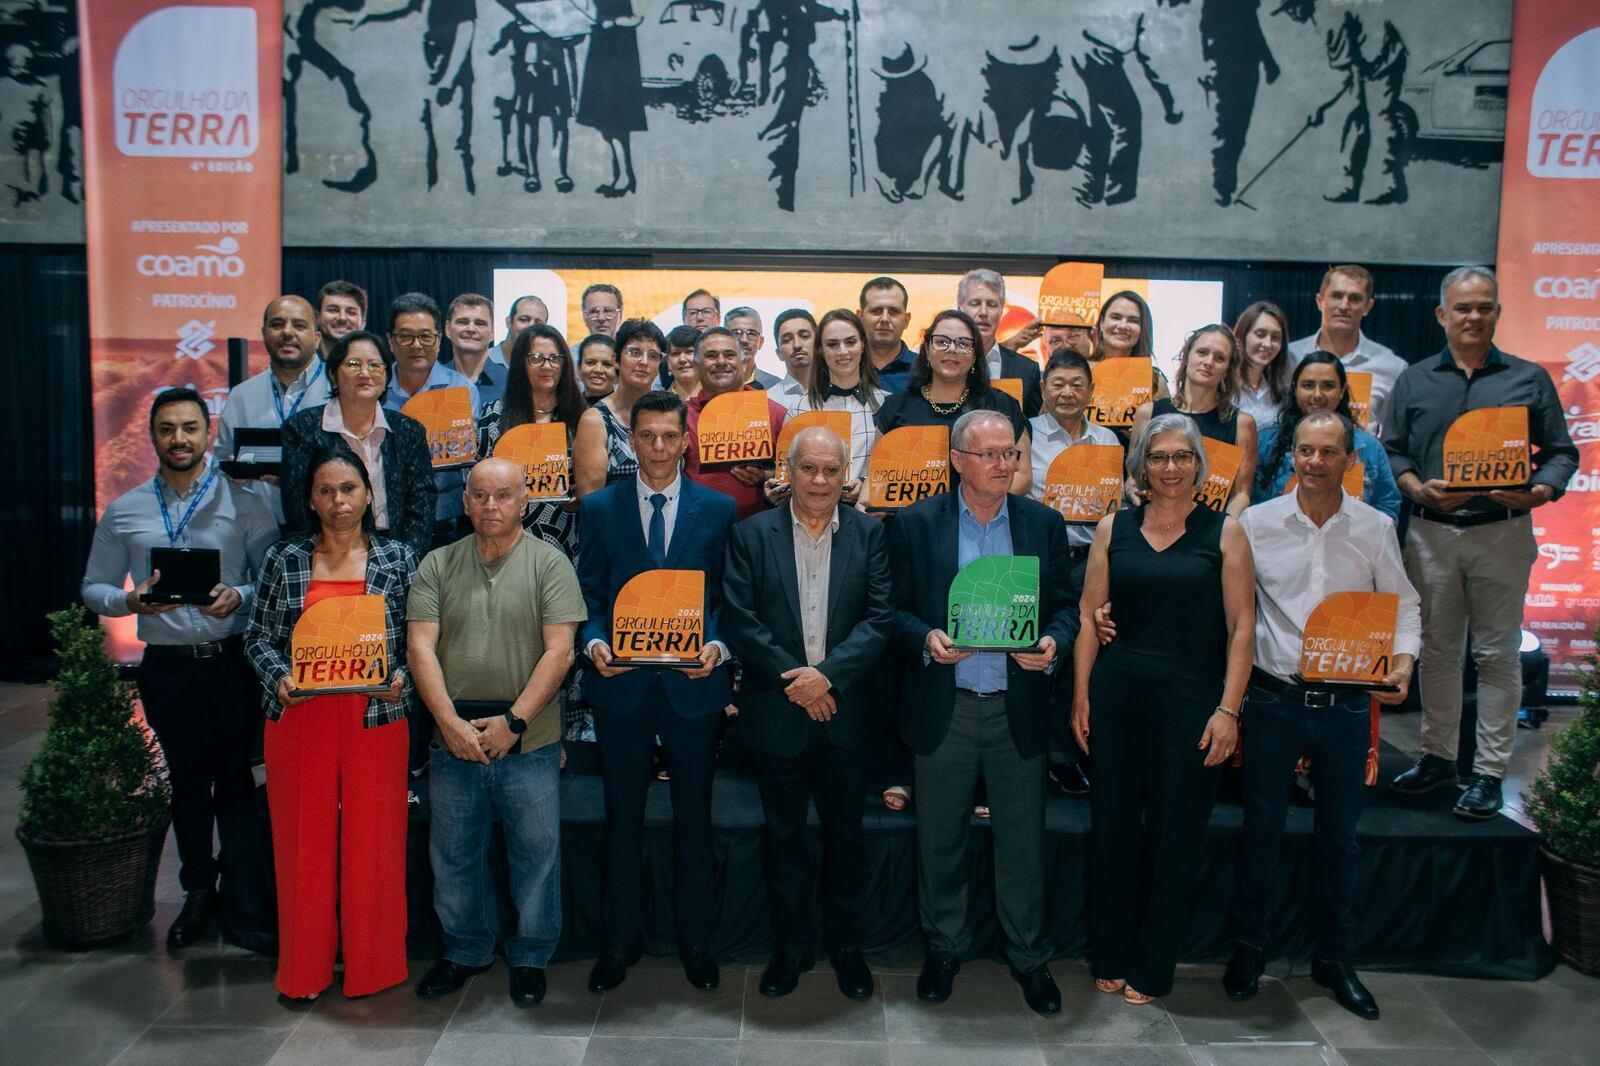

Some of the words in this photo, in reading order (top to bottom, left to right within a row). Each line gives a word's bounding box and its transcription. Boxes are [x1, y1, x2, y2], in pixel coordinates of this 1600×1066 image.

[123, 89, 219, 111] ORGULHO
[224, 91, 250, 111] DA
[124, 112, 250, 146] TERRA
[131, 220, 220, 233] APRESENTADO
[222, 221, 249, 234] POR
[136, 254, 245, 277] coamo
[152, 291, 237, 309] PATROCÍNIO
[1040, 295, 1085, 307] ORGULHO
[452, 419, 471, 427] 2024
[700, 430, 753, 444] ORGULHO
[754, 429, 770, 440] DA
[701, 440, 772, 461] TERRA
[925, 460, 946, 468] 2024
[1446, 461, 1527, 482] TERRA
[872, 469, 929, 482] ORGULHO
[931, 468, 948, 481] DA
[1099, 477, 1120, 486] 2024
[1012, 594, 1036, 603] 2024
[678, 608, 701, 617] 2024
[1017, 605, 1037, 619] DA
[615, 616, 681, 631] ORGULHO
[683, 618, 701, 631] DA
[950, 618, 1035, 641] TERRA
[359, 633, 384, 642] 2024
[616, 630, 700, 652] TERRA
[1368, 631, 1392, 640] 2024
[294, 643, 363, 661] ORGULHO
[365, 642, 385, 657] DA
[1304, 637, 1368, 653] ORGULHO
[295, 657, 385, 684] TERRA
[1304, 651, 1389, 676] TERRA
